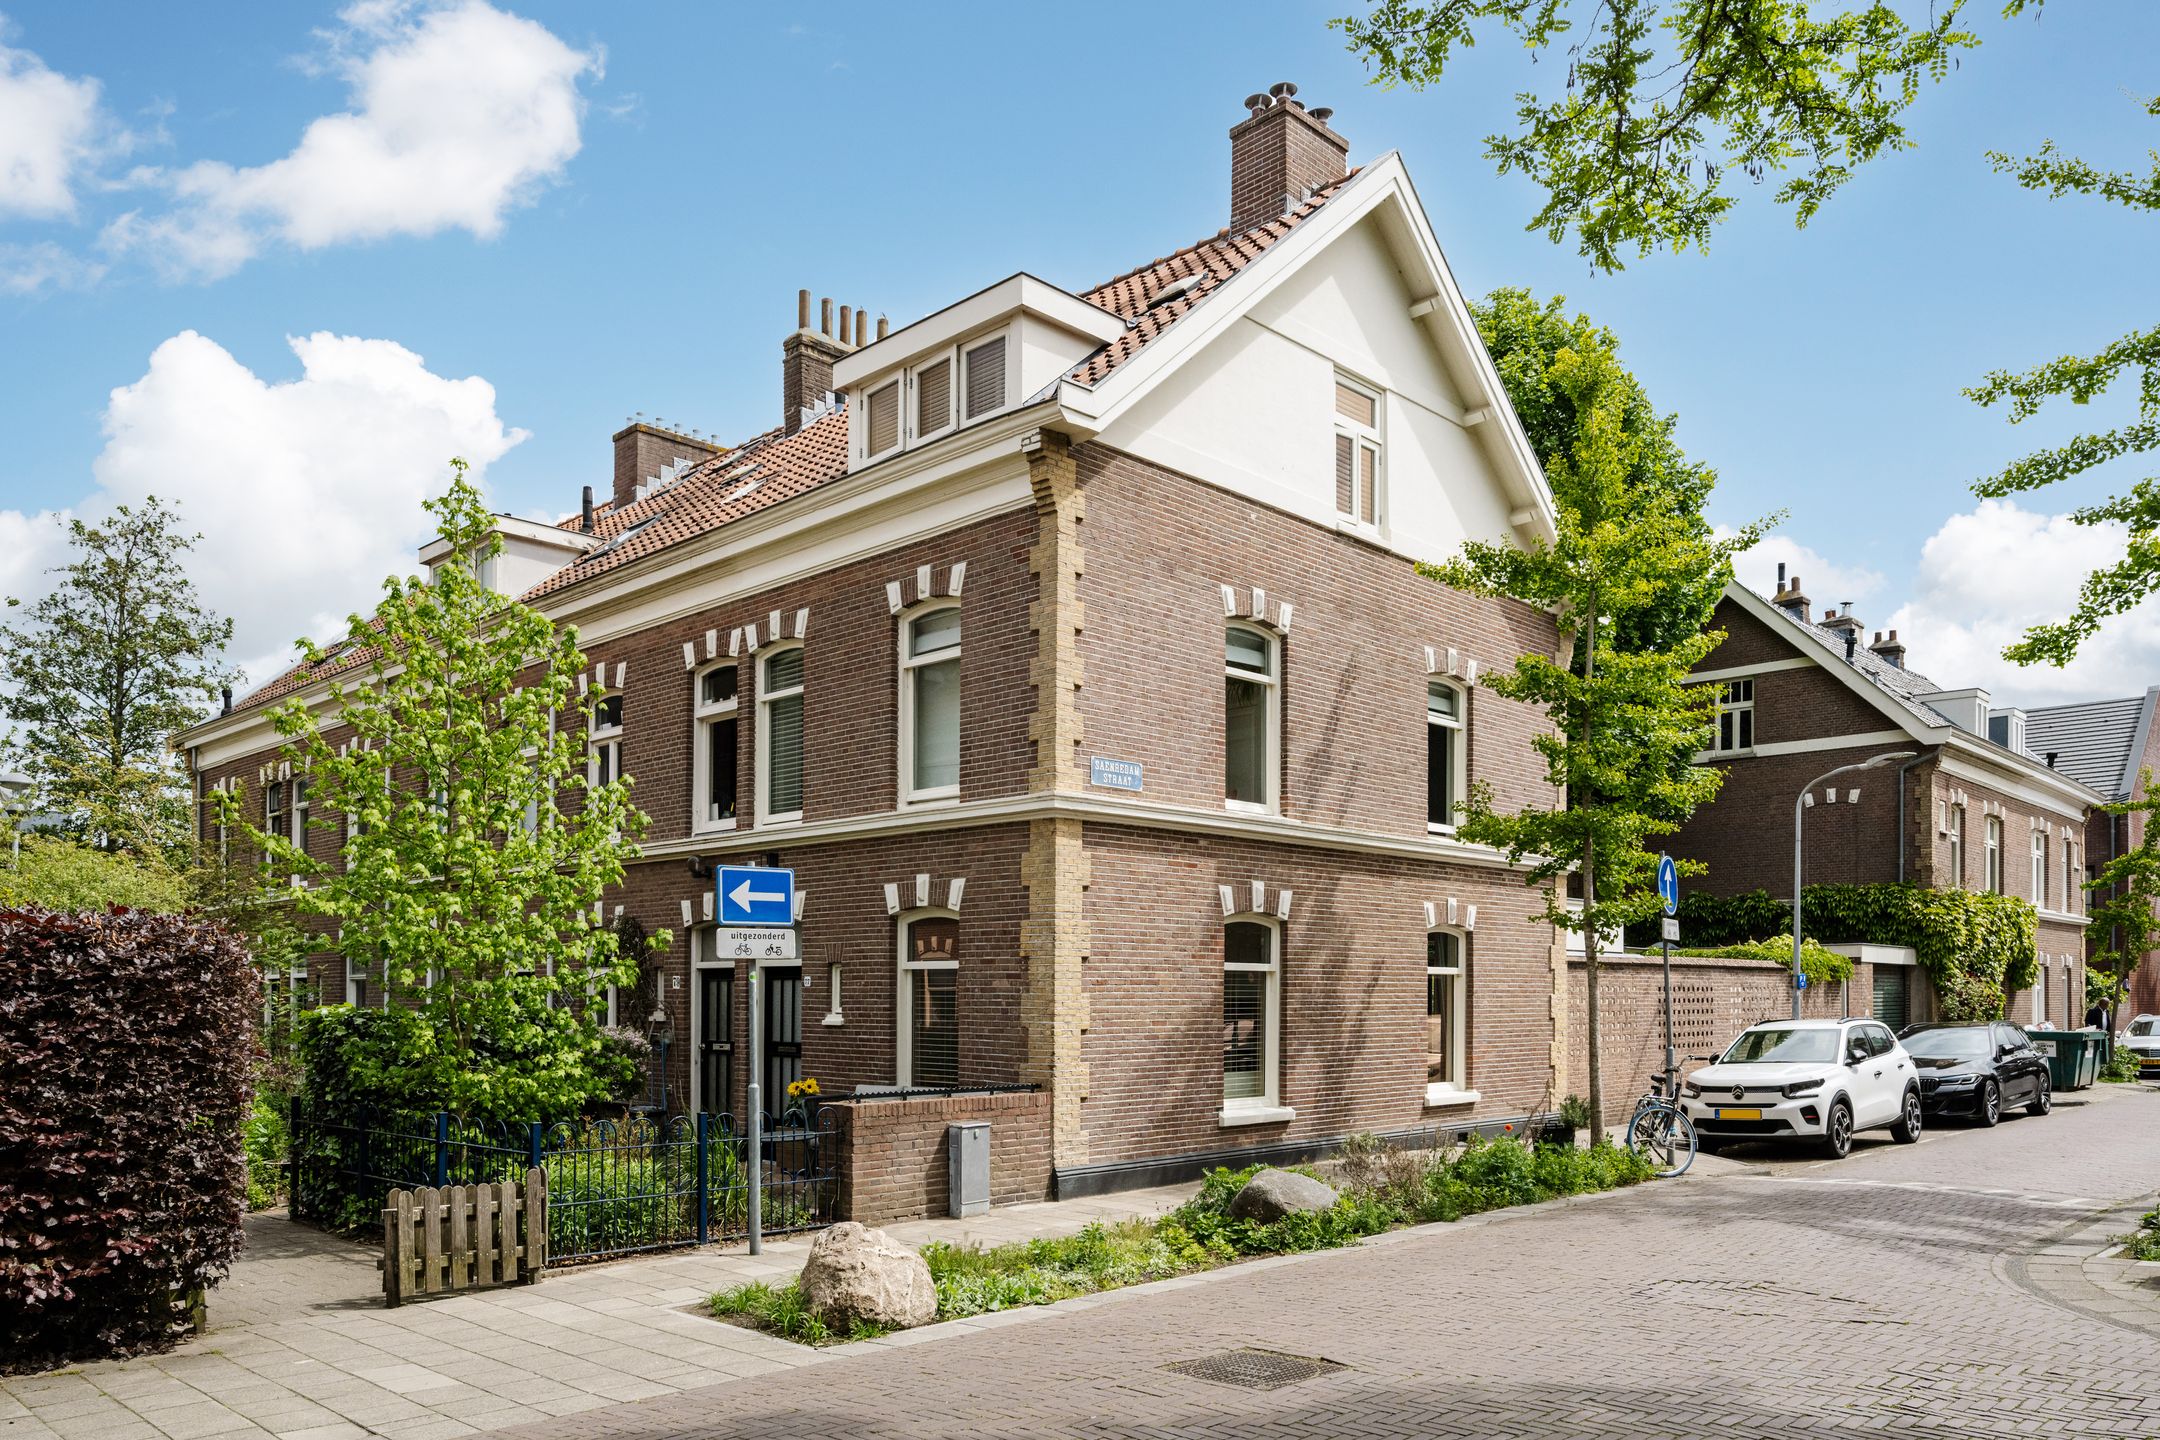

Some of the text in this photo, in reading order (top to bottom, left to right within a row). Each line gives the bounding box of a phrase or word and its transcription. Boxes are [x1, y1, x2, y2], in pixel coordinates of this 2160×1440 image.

[1095, 760, 1140, 776] SAENREDAM
[1103, 773, 1132, 786] STRAAT
[731, 931, 786, 941] uitgezonderd
